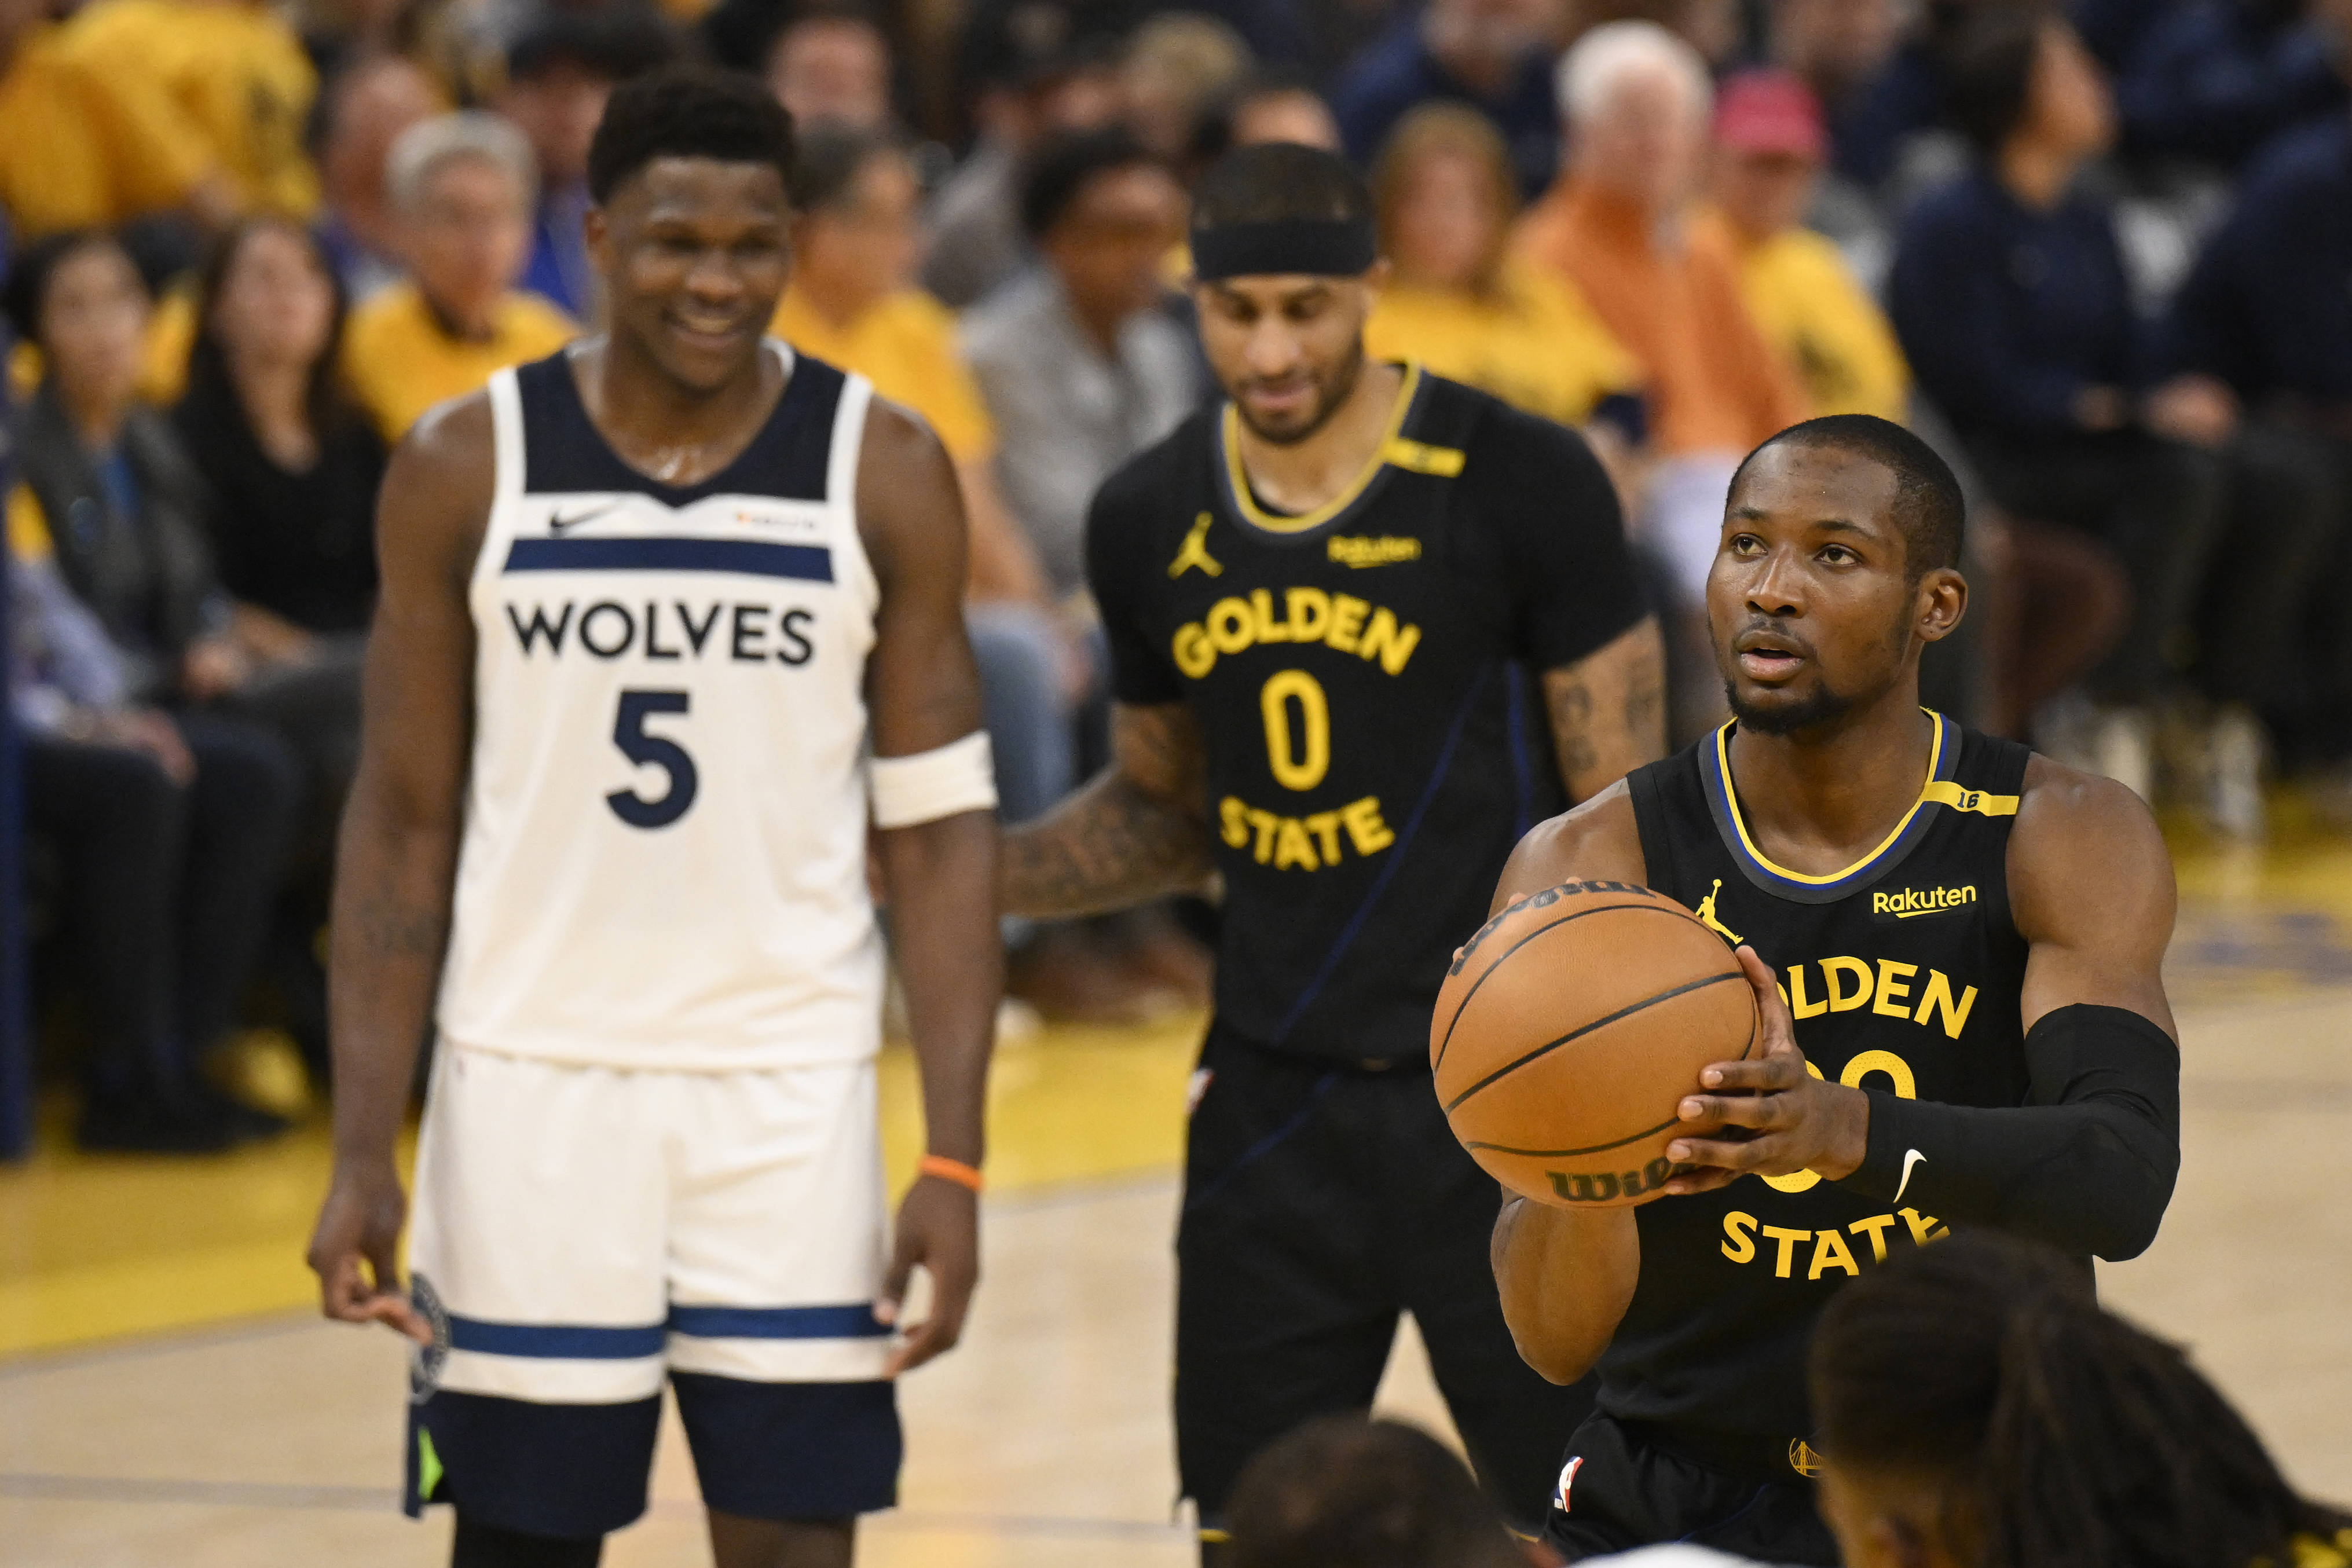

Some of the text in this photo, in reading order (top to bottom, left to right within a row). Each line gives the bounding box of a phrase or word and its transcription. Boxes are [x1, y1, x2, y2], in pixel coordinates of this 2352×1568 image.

[506, 601, 814, 668] WOLVES
[1171, 586, 1422, 680] GOLDEN
[605, 688, 699, 831] 5
[1260, 669, 1331, 792] 0
[1219, 796, 1396, 872] STATE
[1957, 792, 1980, 808] 16
[1873, 885, 1976, 914] Rakuten
[1776, 955, 1979, 1040] LDEN
